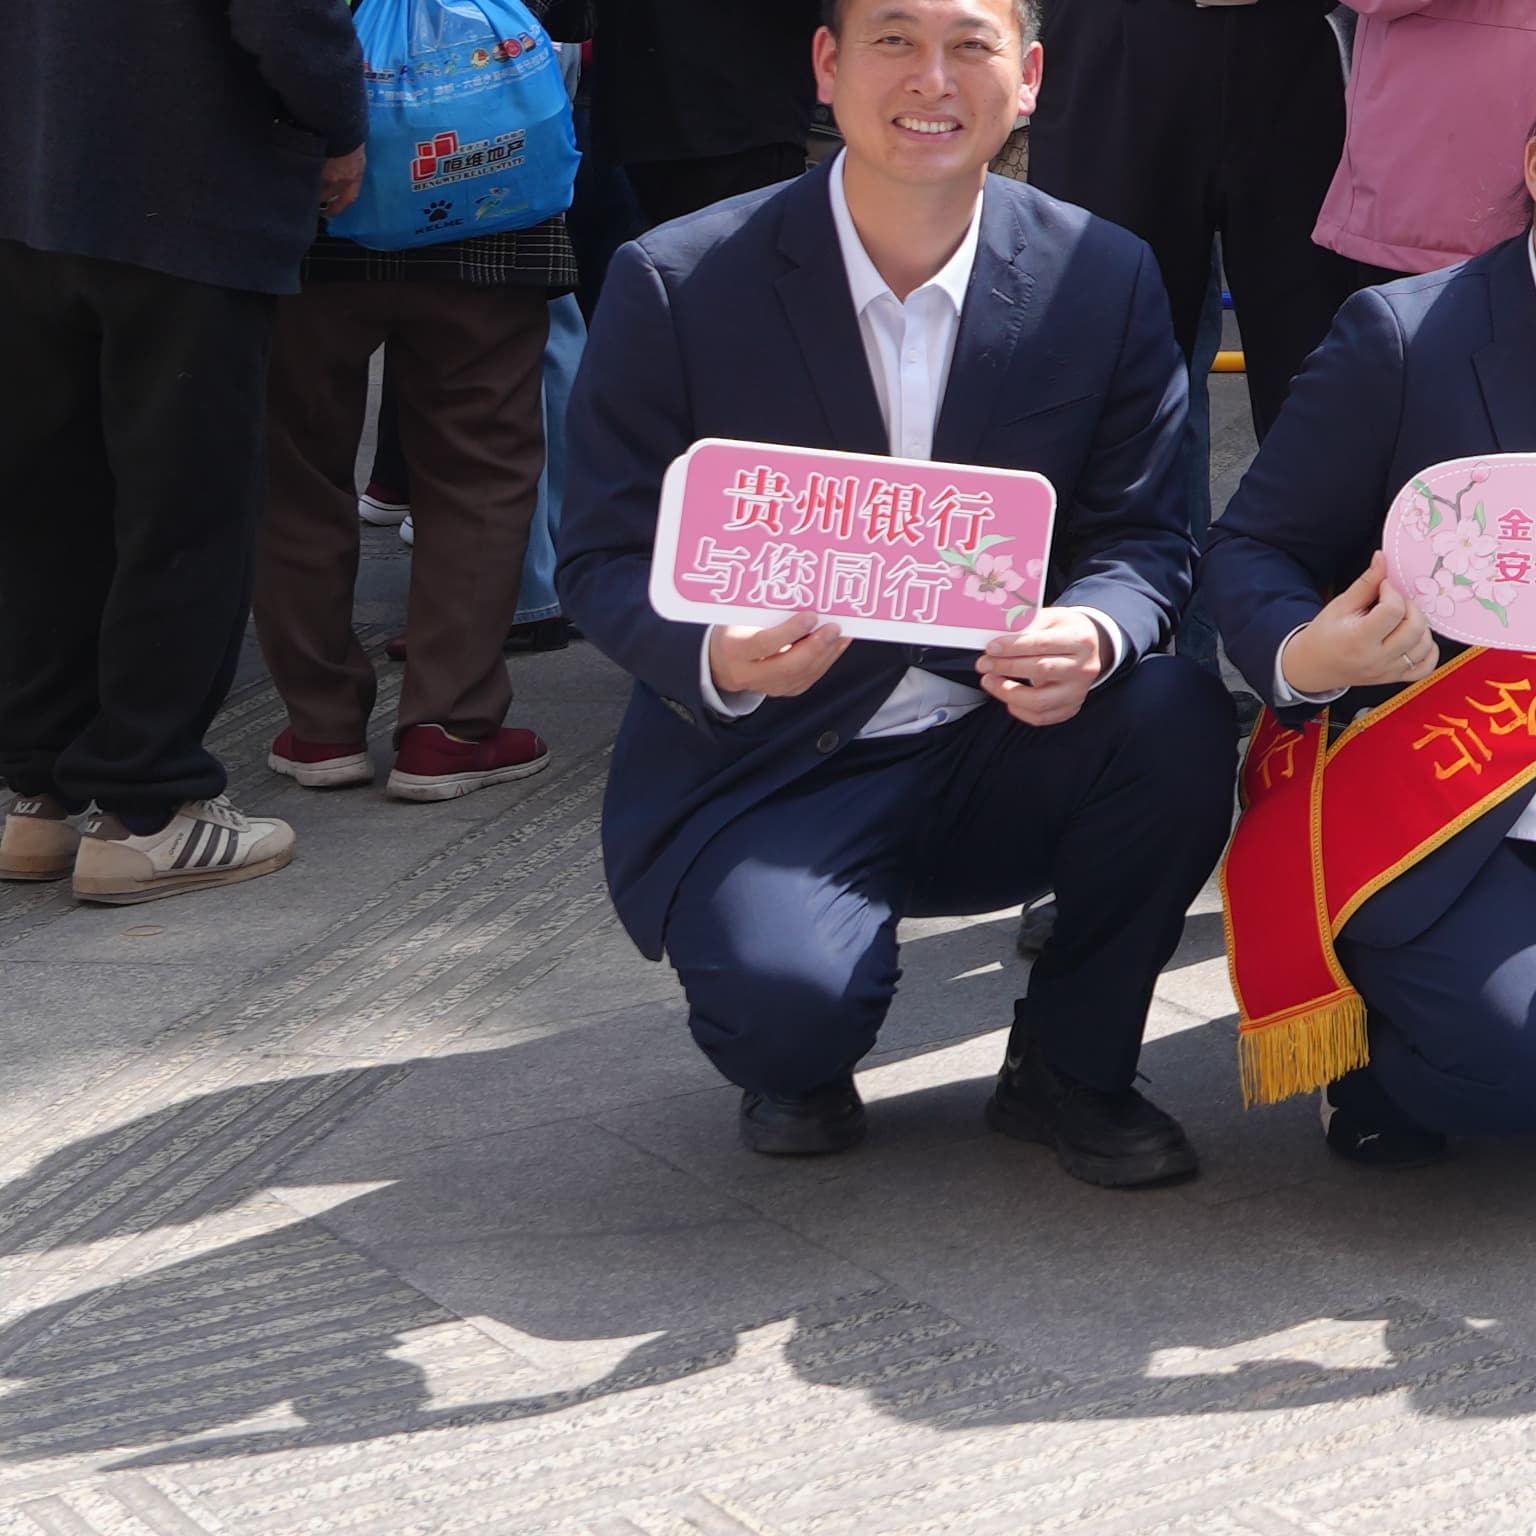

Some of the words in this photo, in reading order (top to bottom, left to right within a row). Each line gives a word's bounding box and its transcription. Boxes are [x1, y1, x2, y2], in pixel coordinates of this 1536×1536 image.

[724, 465, 995, 552] 贵州银行
[683, 536, 953, 624] 与您同行
